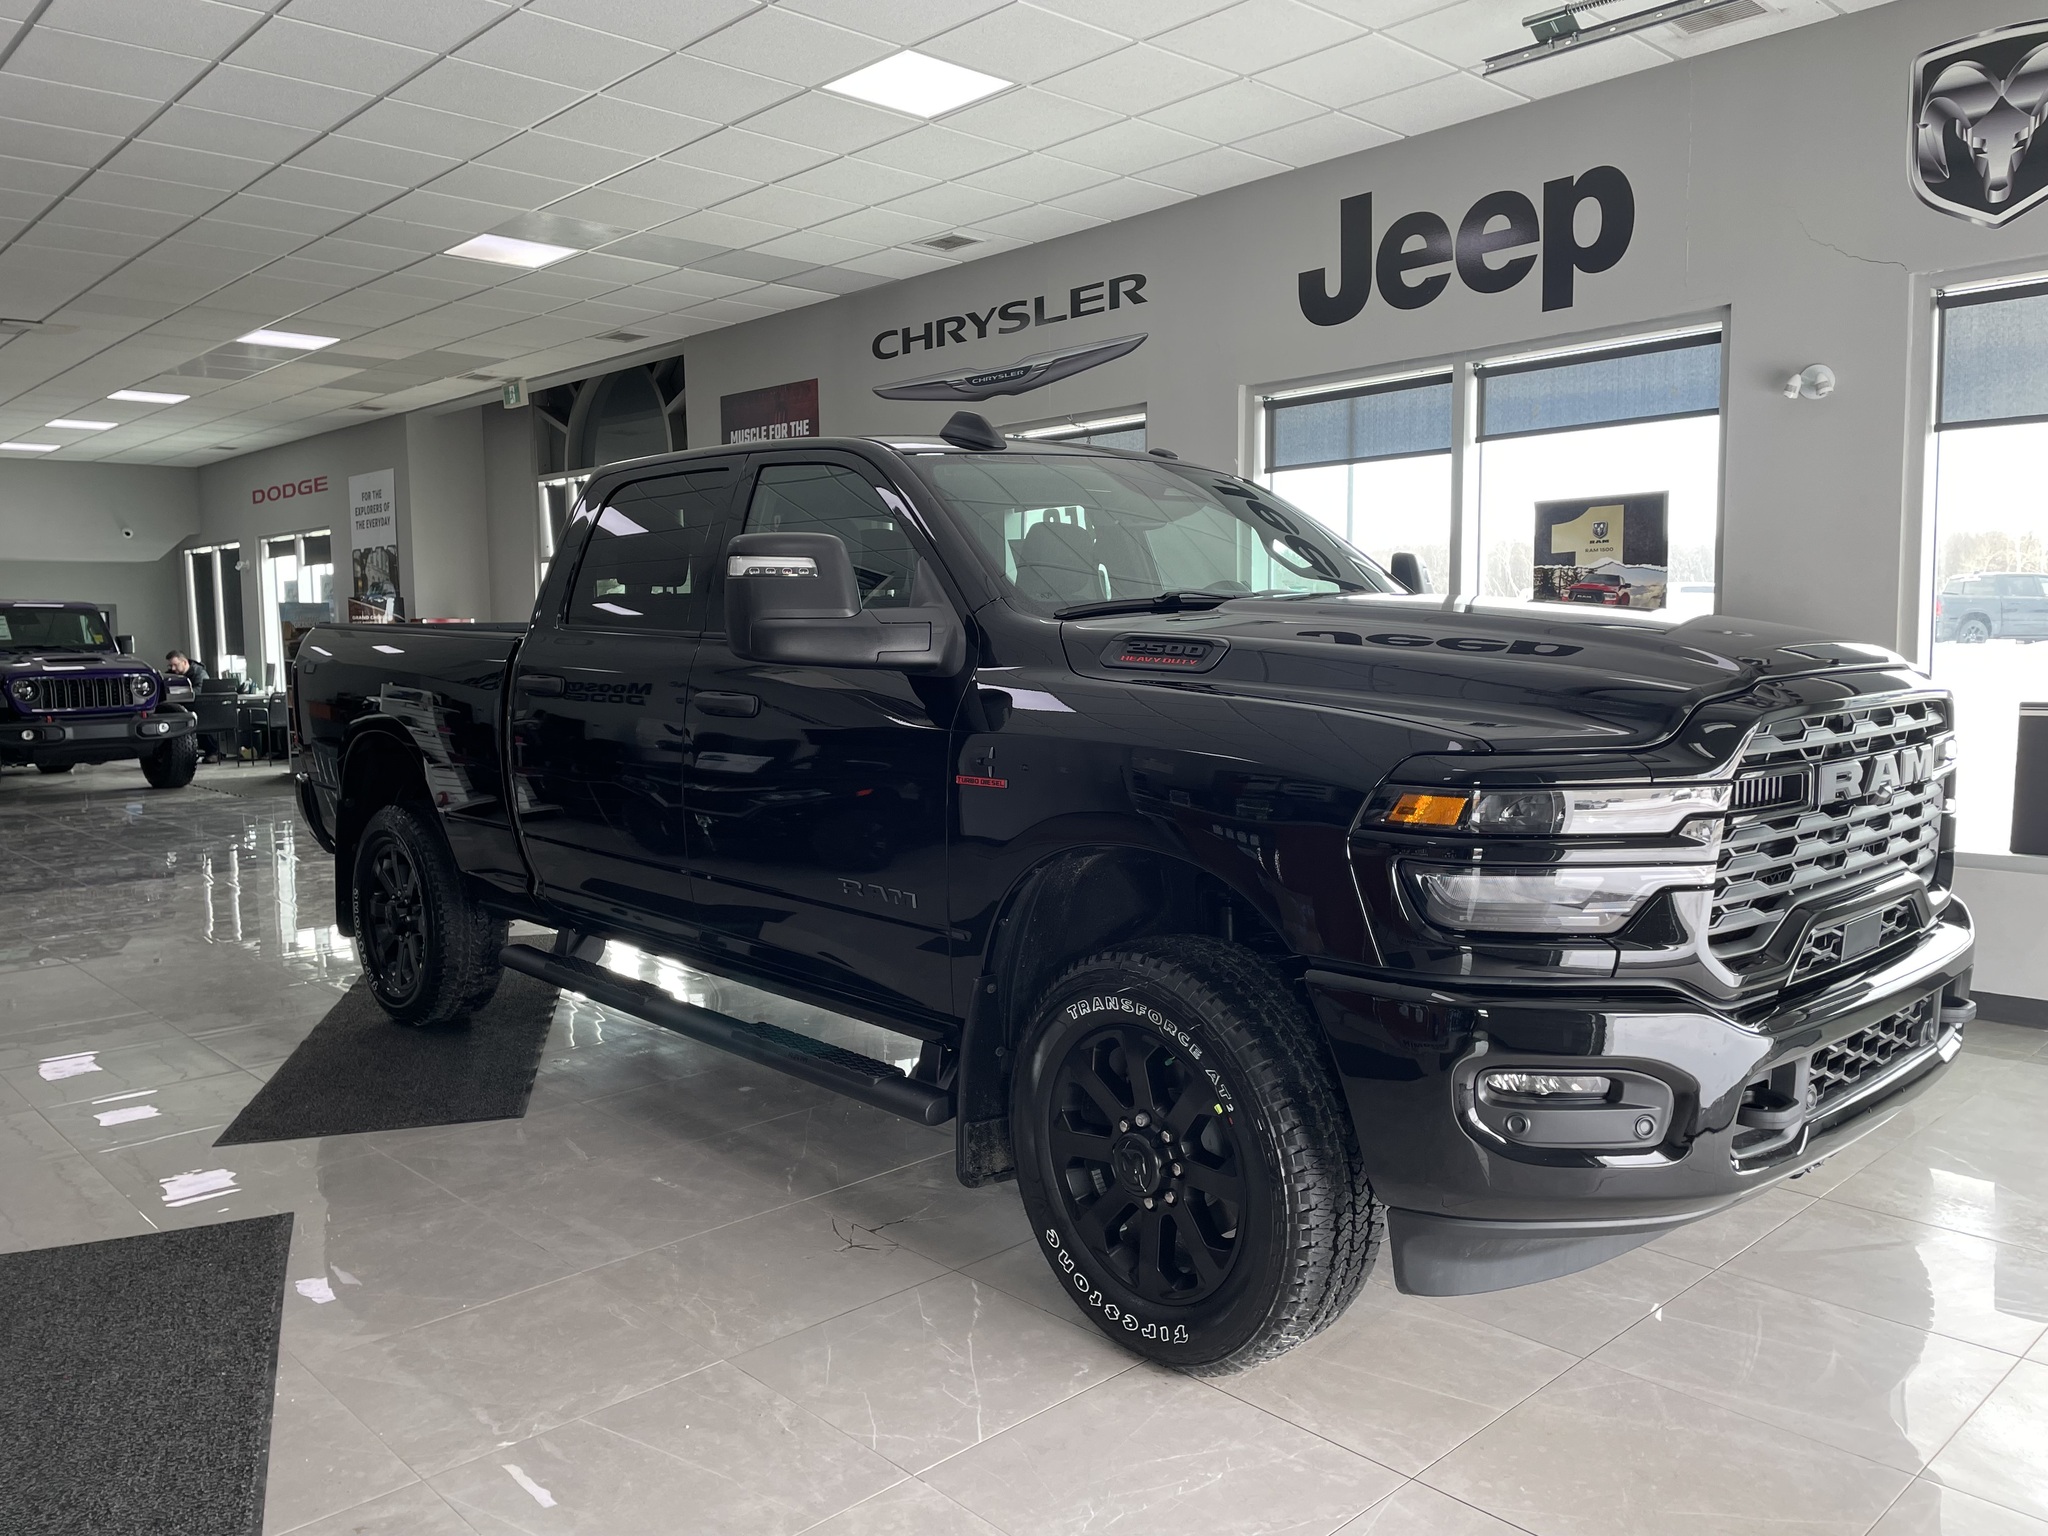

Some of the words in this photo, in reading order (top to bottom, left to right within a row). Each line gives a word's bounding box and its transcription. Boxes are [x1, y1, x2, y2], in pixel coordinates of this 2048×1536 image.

[1298, 165, 1635, 326] Jeep
[872, 273, 1148, 360] CHRYSLER
[971, 369, 1024, 384] CHRYSLER
[730, 426, 767, 444] MUSCLE
[769, 422, 788, 440] FOR
[790, 419, 810, 437] THE
[252, 476, 328, 504] DODGE
[361, 491, 371, 501] FOR
[372, 489, 382, 499] THE
[355, 503, 382, 516] EXPLORERS
[383, 502, 390, 512] OF
[356, 520, 365, 530] THE
[366, 516, 391, 529] EVERYDAY
[1127, 641, 1206, 657] 2500
[1120, 655, 1161, 663] HEAVY
[957, 776, 980, 784] TURBO
[980, 778, 1004, 786] DIESEL
[1819, 743, 1933, 806] RAM
[1066, 996, 1202, 1060] TRANSFORCE
